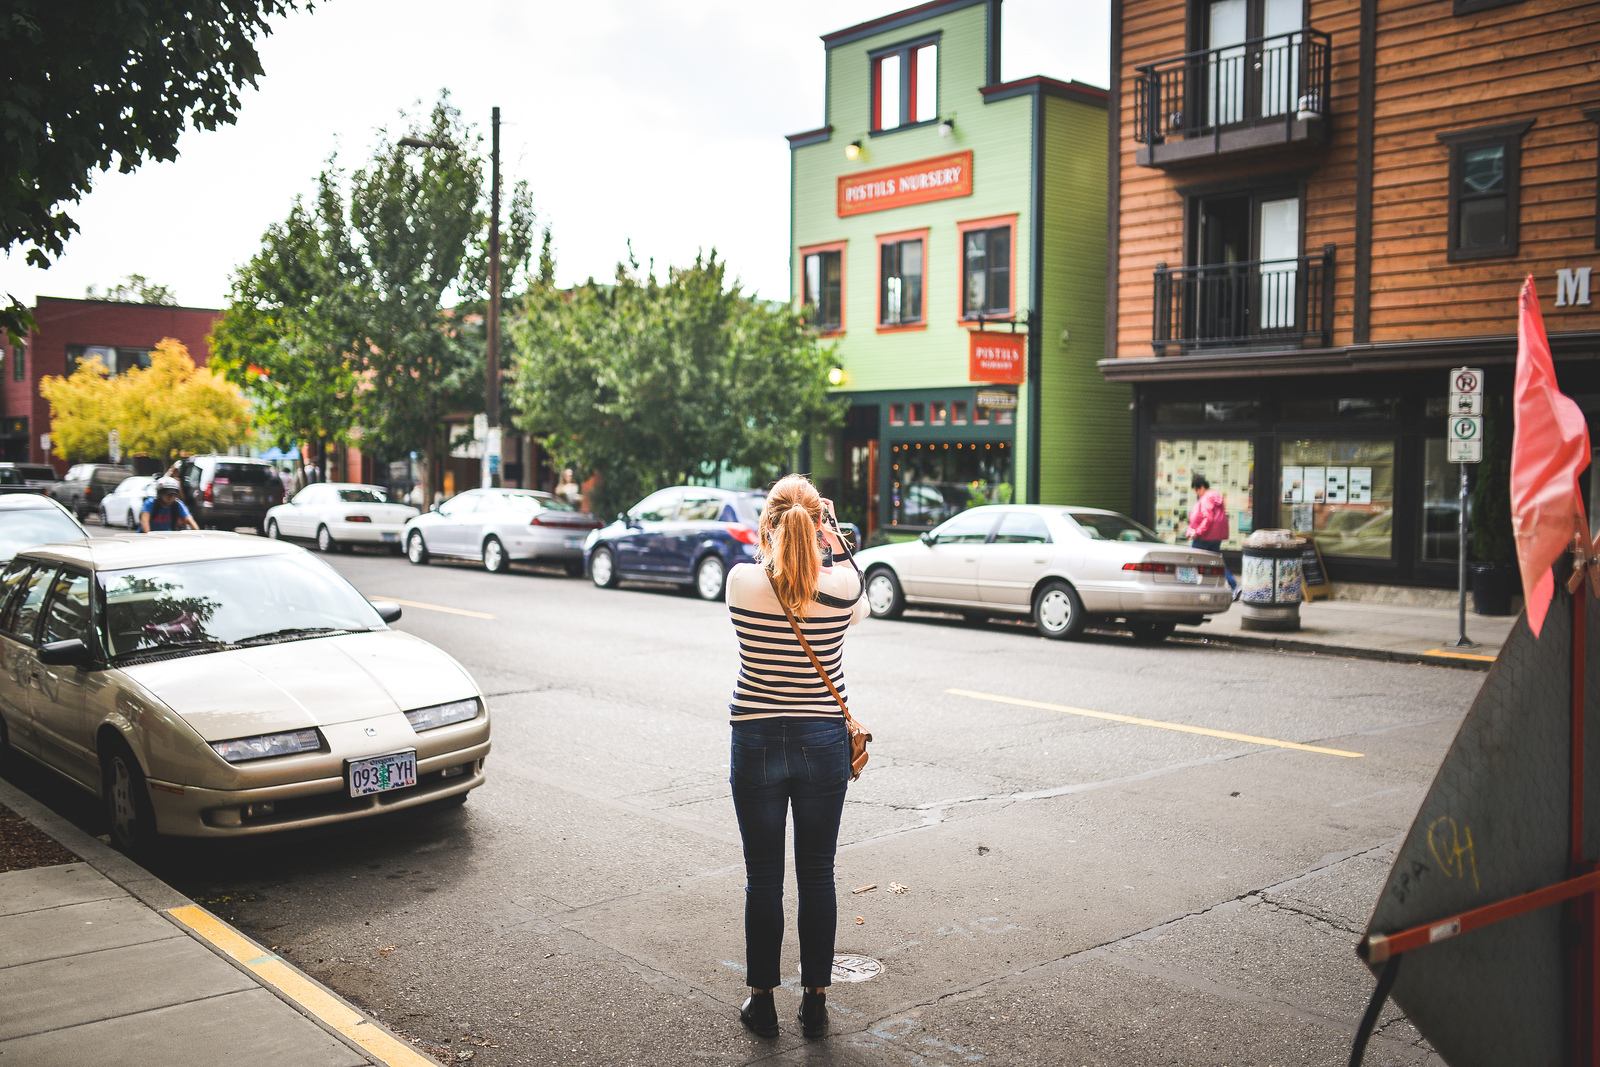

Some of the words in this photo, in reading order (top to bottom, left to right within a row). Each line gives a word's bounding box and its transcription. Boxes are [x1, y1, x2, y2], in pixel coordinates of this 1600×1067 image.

[846, 179, 895, 202] PISTILS
[900, 167, 961, 192] NURSERY
[1554, 267, 1592, 306] M
[354, 768, 379, 787] 093
[387, 761, 412, 781] FYH
